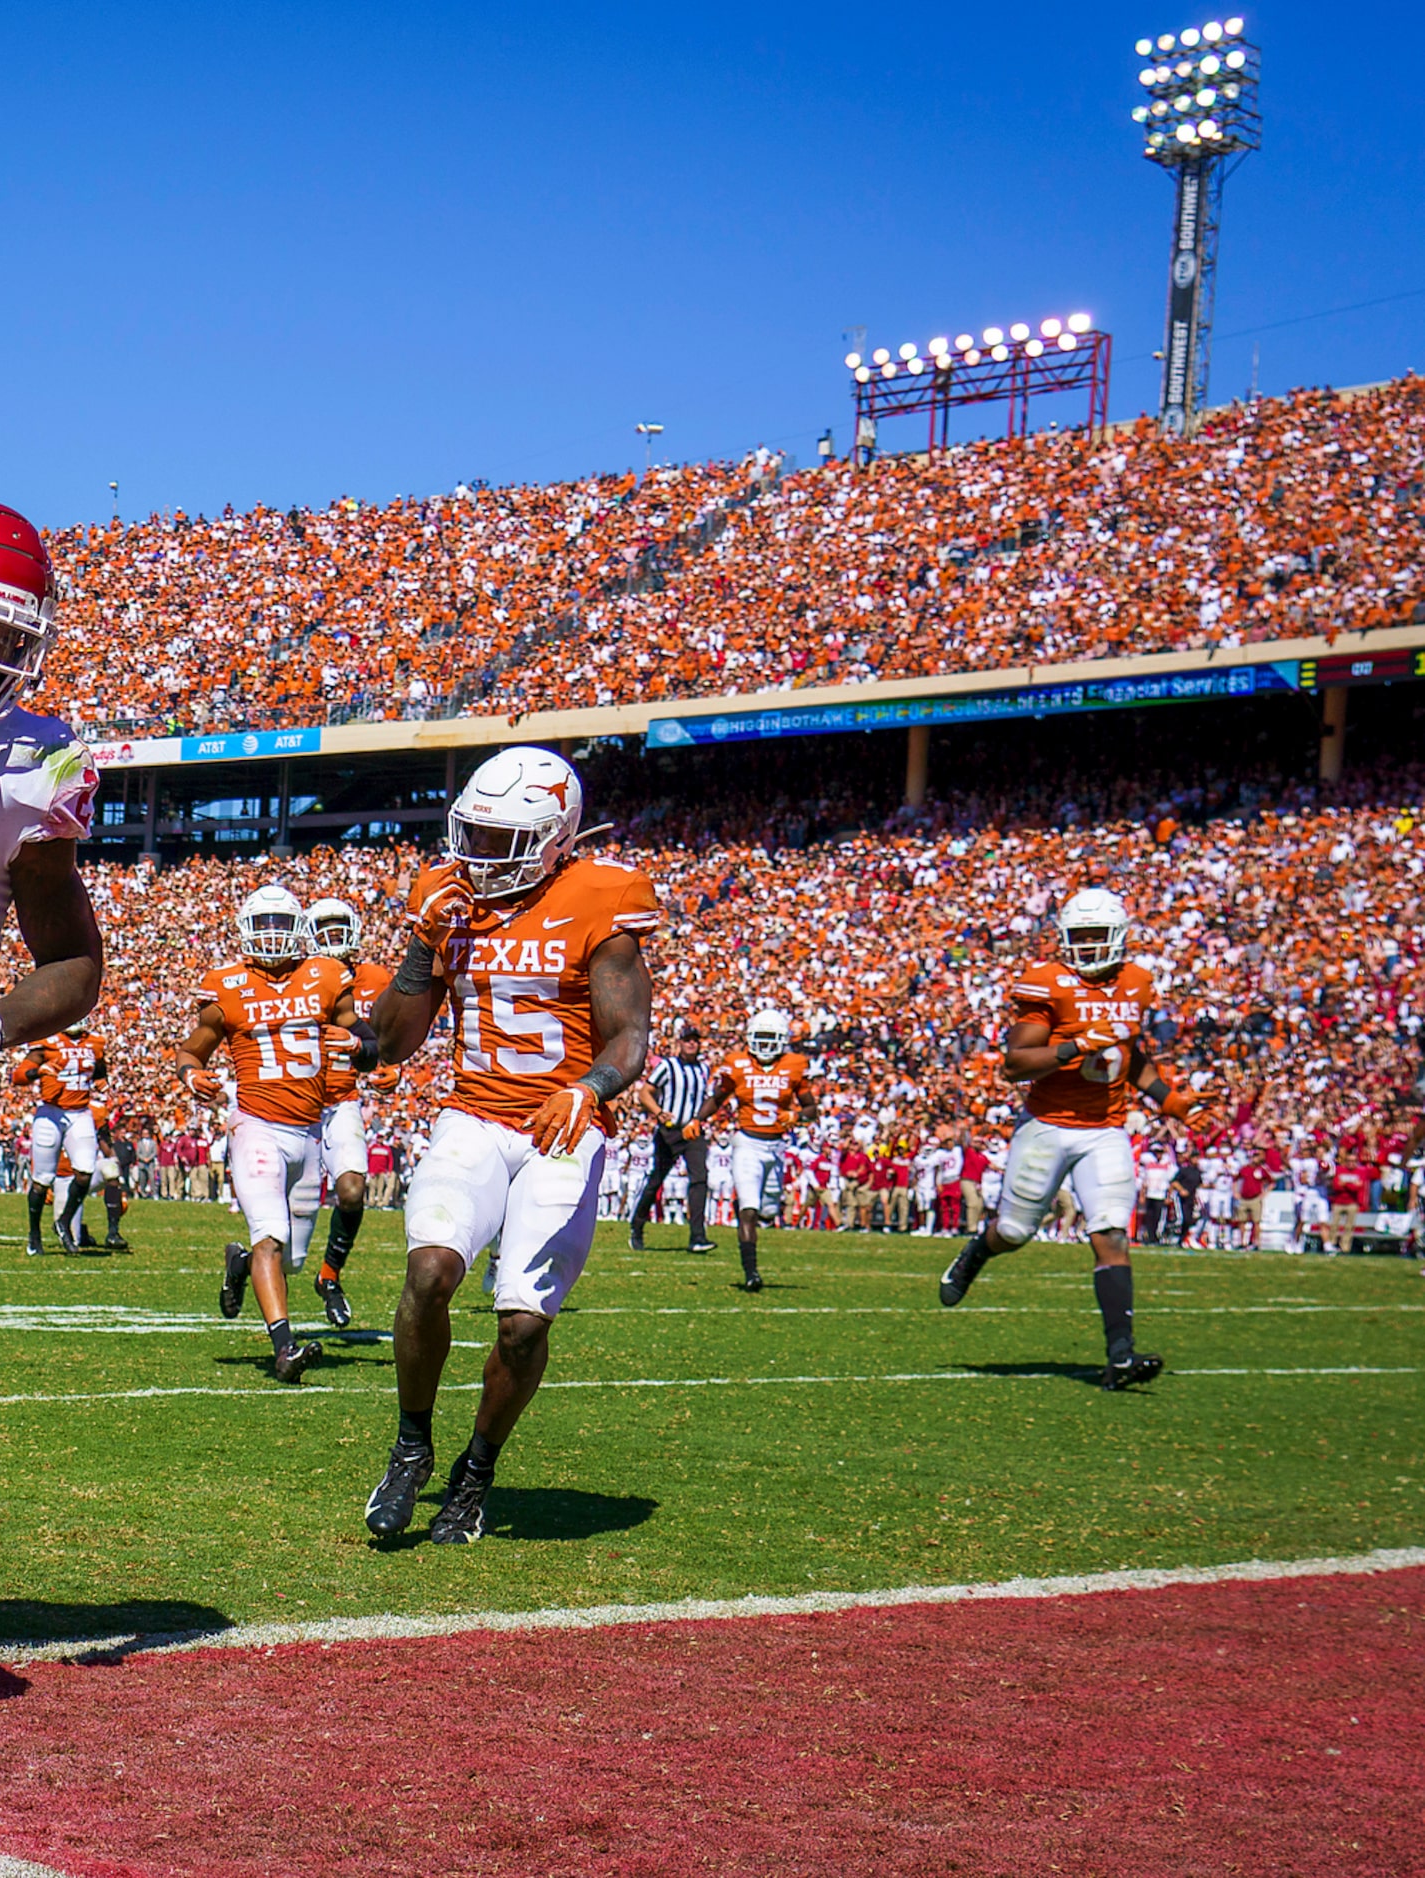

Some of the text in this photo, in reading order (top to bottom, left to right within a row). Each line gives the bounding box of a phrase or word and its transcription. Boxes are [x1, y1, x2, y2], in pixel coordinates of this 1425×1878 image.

[198, 741, 226, 755] AT&T
[275, 734, 304, 749] AT&T
[447, 937, 567, 974] TEXAS
[243, 994, 322, 1023] TEXAS
[1074, 1001, 1140, 1022] TEXAS
[453, 974, 566, 1075] 15
[59, 1047, 95, 1059] TEXAS
[250, 1017, 322, 1081] 19
[56, 1058, 96, 1091] 42
[744, 1074, 789, 1090] TEXAS
[752, 1088, 780, 1126] 5
